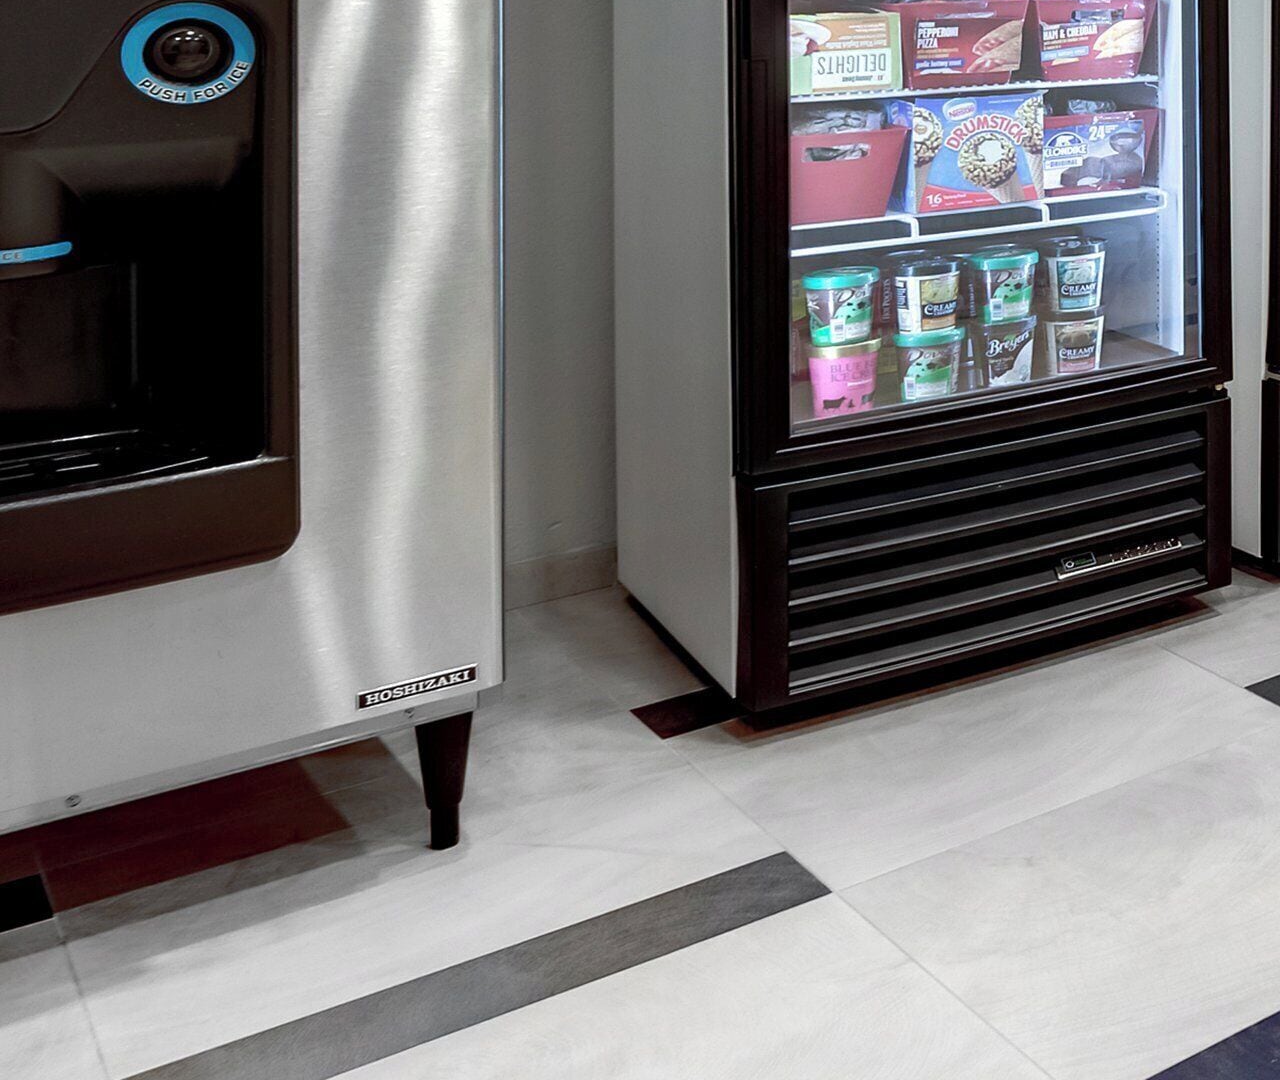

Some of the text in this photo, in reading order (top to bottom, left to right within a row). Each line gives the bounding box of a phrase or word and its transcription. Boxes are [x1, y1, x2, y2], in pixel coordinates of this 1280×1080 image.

[917, 38, 938, 49] PIZZA
[817, 53, 887, 75] DELIGHTS
[137, 59, 250, 103] PUSH FOR ICE
[945, 114, 1025, 151] DRUMSTICK
[1089, 125, 1105, 141] 24
[1044, 144, 1088, 156] KLONDIKE
[926, 192, 942, 205] 16
[986, 331, 1030, 357] Breyers
[364, 669, 472, 706] HOSHIZAKI
